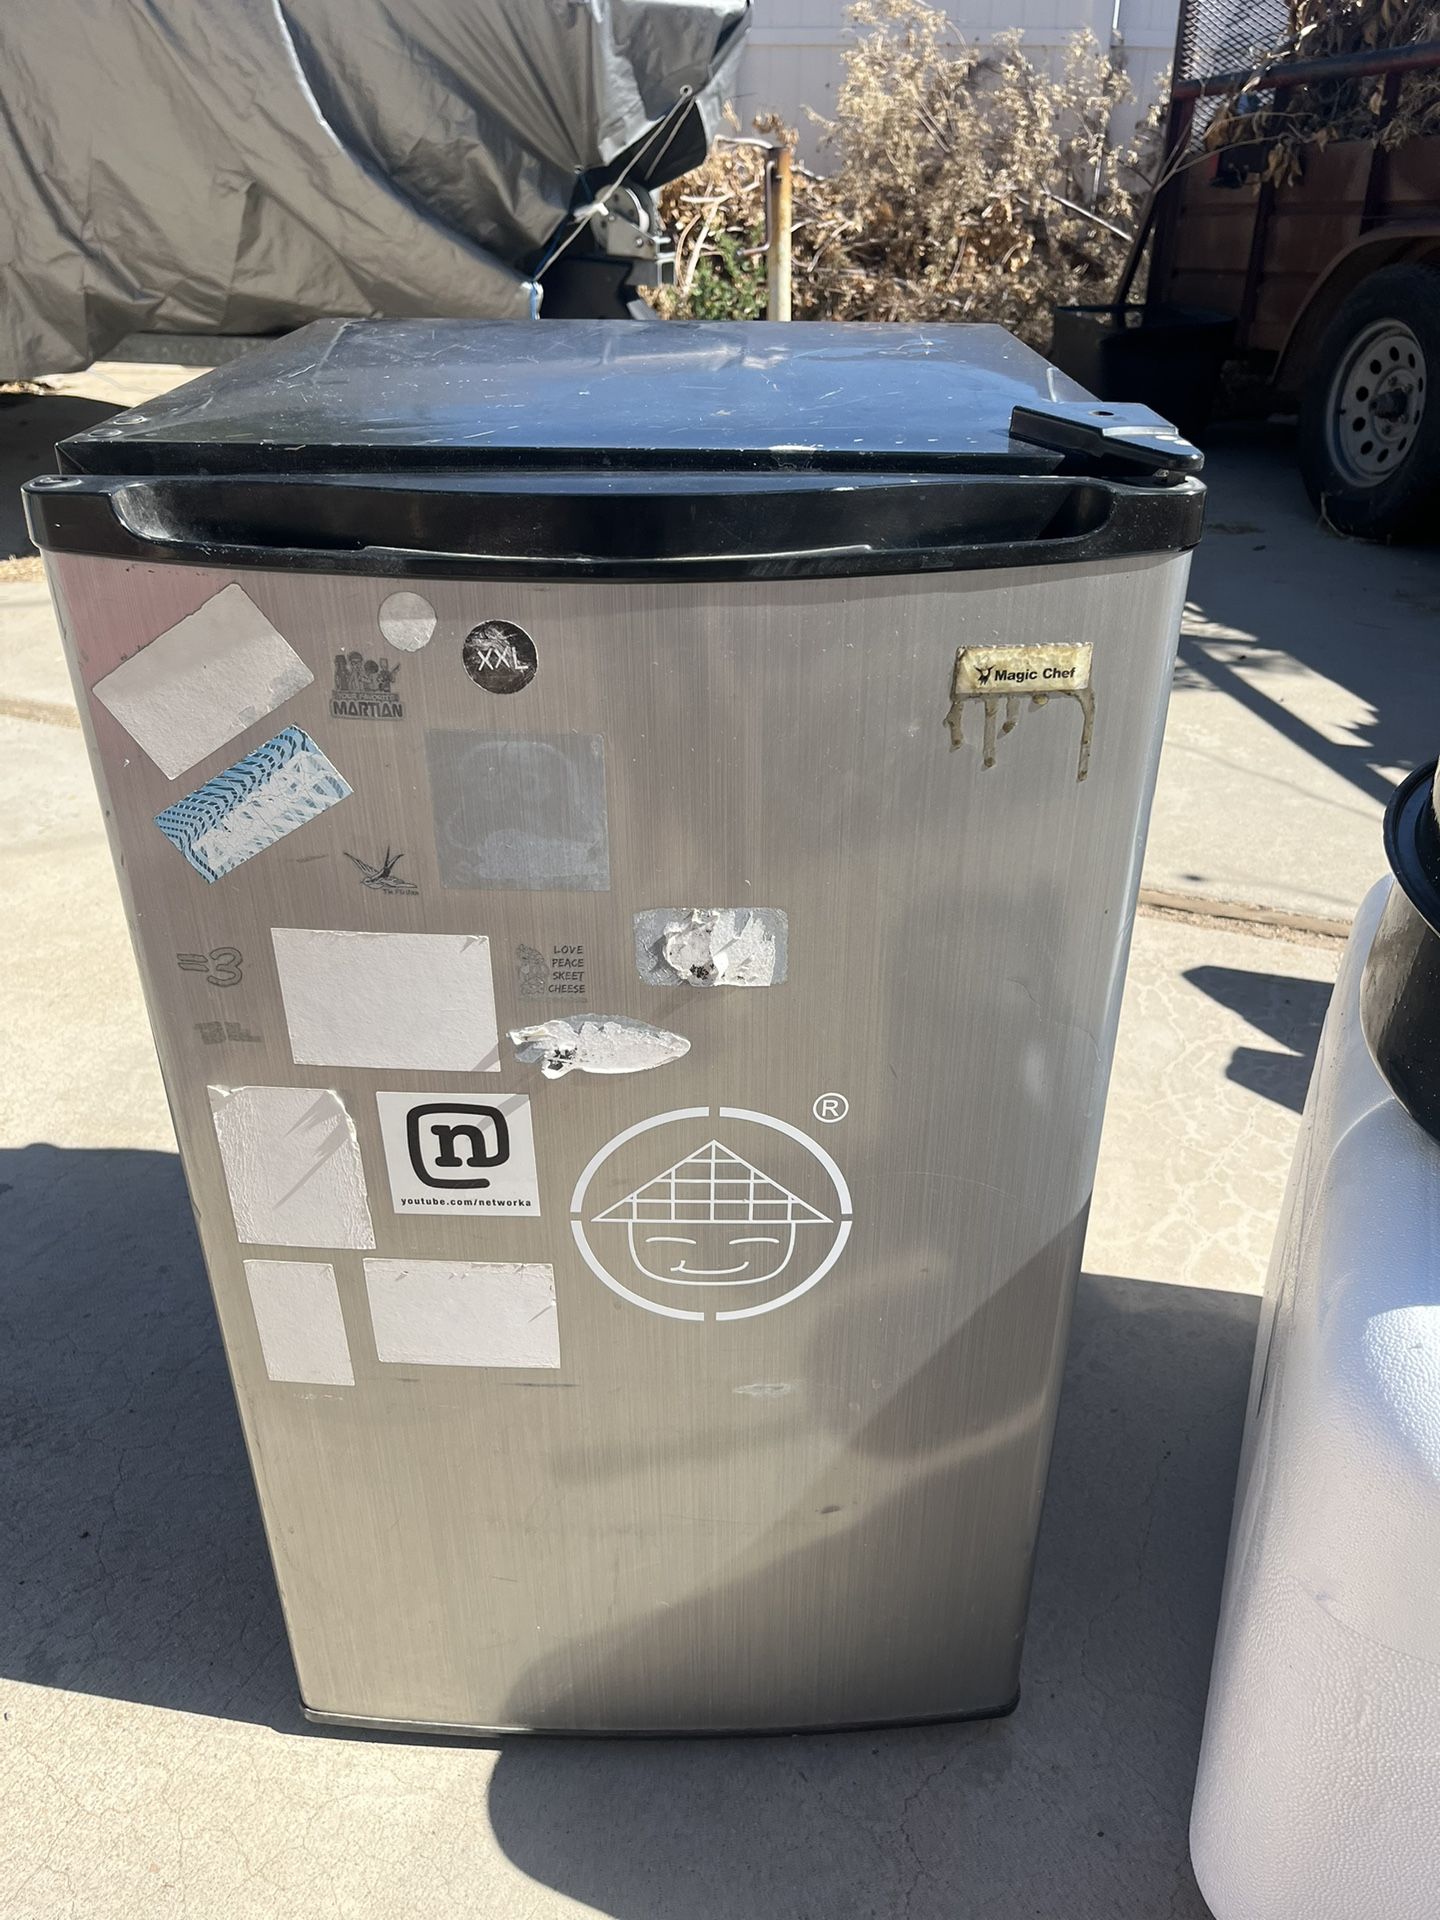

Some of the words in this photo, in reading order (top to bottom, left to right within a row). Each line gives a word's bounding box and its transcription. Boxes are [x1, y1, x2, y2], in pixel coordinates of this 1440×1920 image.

[477, 646, 529, 671] XXL
[994, 668, 1038, 683] Magic
[1042, 666, 1076, 679] Chef
[332, 701, 404, 718] MARTIAN
[553, 945, 584, 954] LOVE
[552, 958, 585, 968] PEACE
[552, 971, 585, 981] SKEET
[548, 984, 586, 994] CHEESE
[400, 1197, 532, 1207] youtube.com/networka
